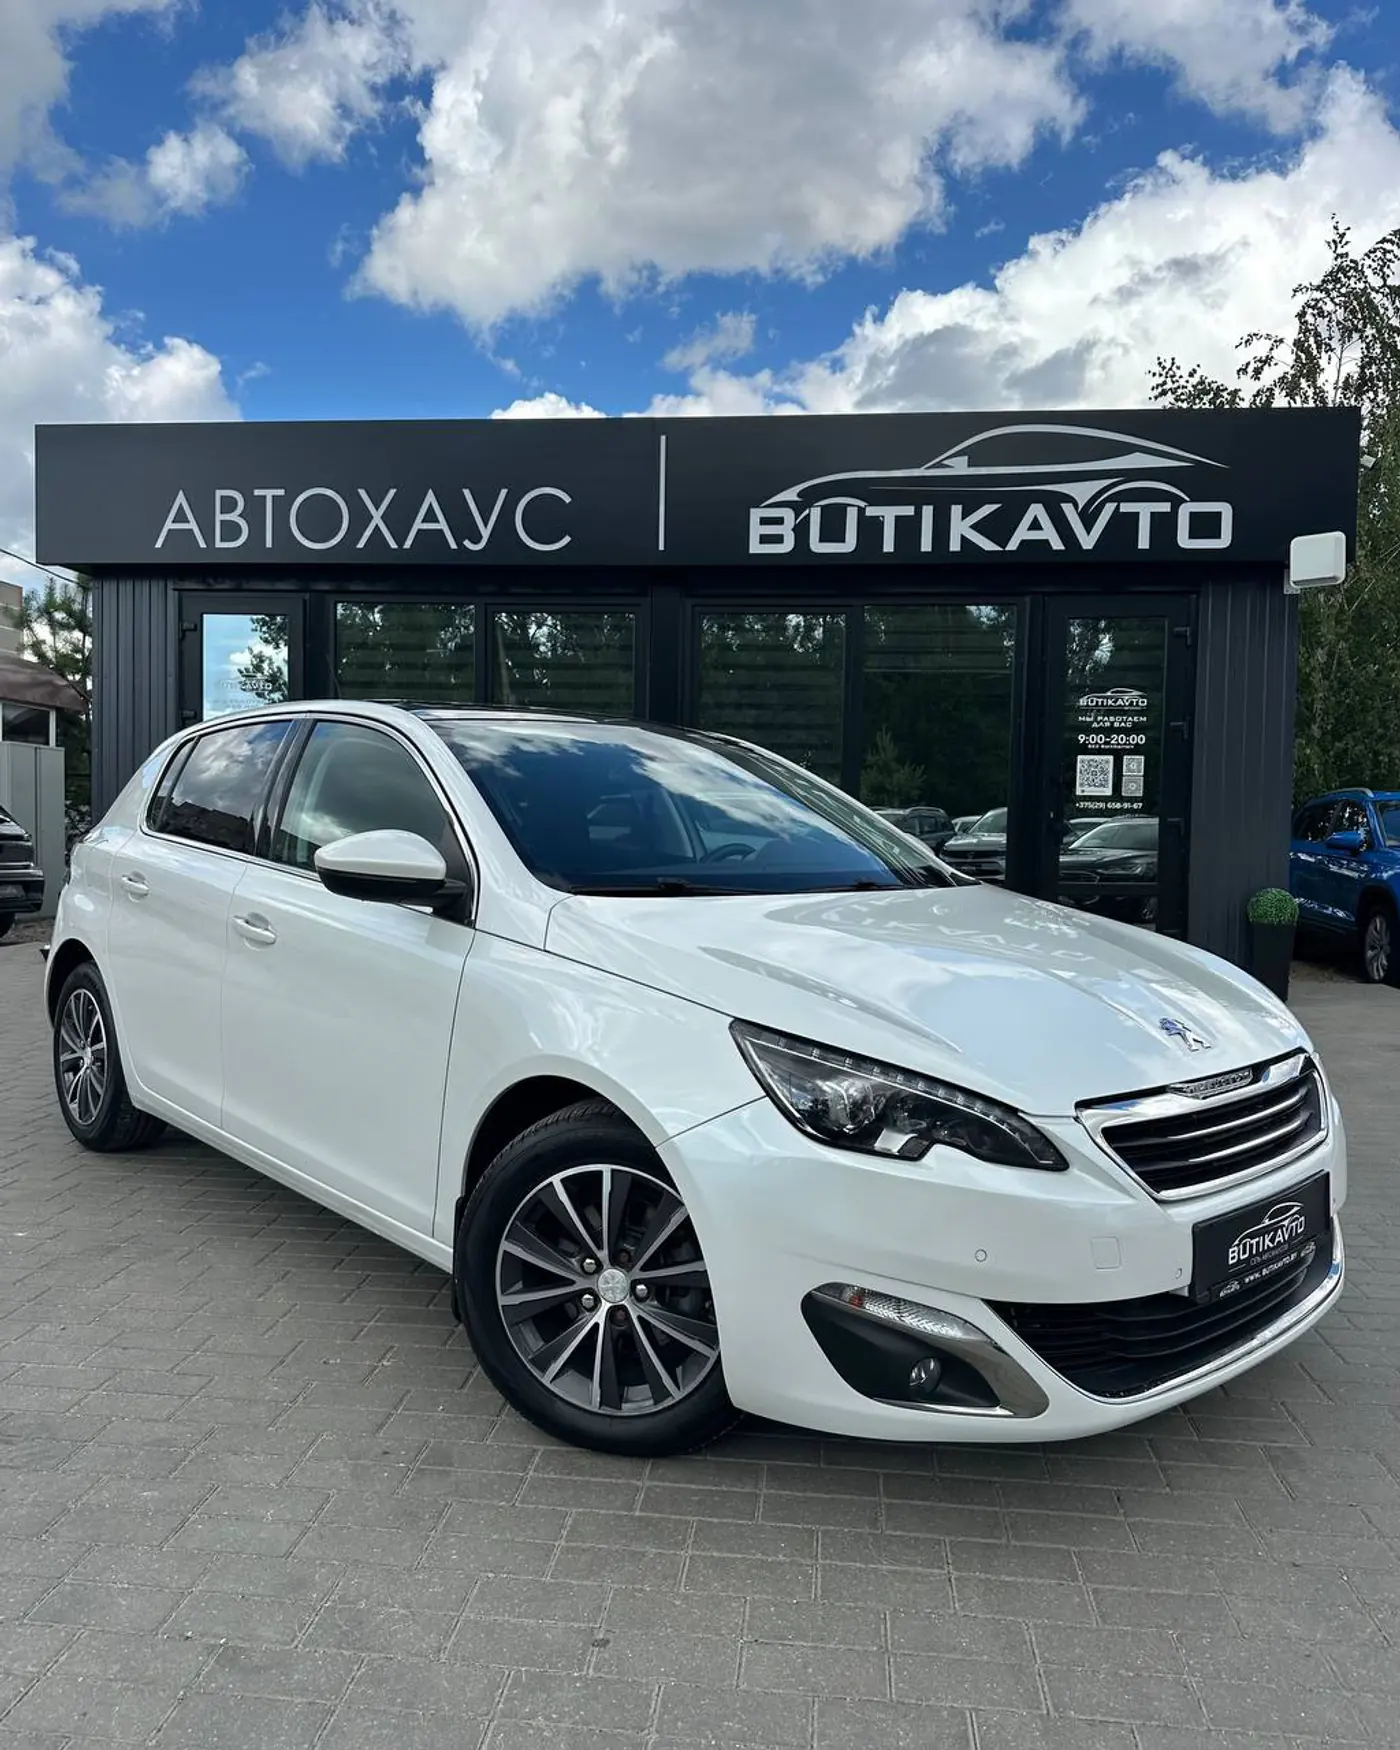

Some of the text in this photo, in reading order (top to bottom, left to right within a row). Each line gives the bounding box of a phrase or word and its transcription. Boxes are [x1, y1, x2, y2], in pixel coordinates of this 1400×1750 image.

[155, 487, 572, 551] АВТОХАУС
[749, 501, 1233, 554] BUTIKAVTO
[1078, 734, 1146, 745] 9:00-20:00
[1228, 1216, 1306, 1265] BUTIKAVTO
